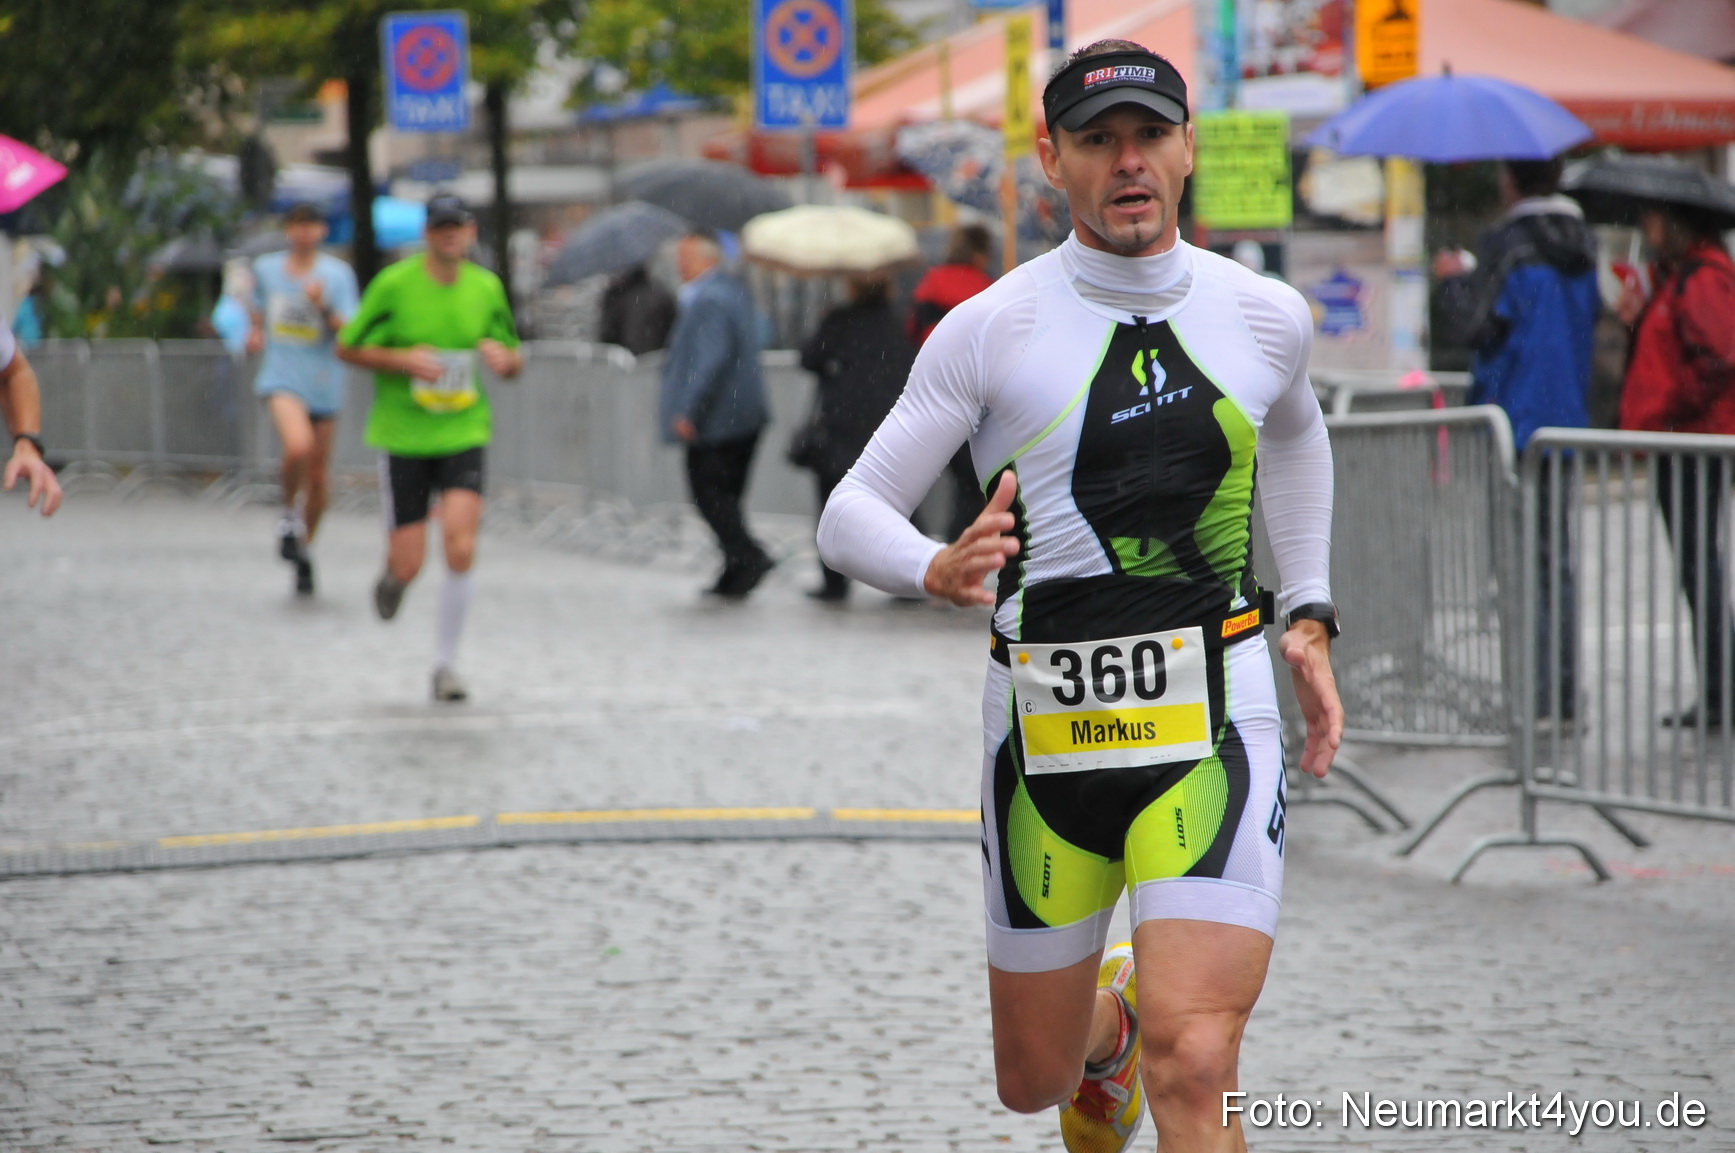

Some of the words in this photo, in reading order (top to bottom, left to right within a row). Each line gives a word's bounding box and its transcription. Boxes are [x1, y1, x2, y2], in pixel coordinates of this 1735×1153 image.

[1050, 640, 1168, 707] 360
[1071, 718, 1157, 746] Markus
[1175, 806, 1187, 850] SCOTT
[1041, 851, 1052, 899] SCOTT
